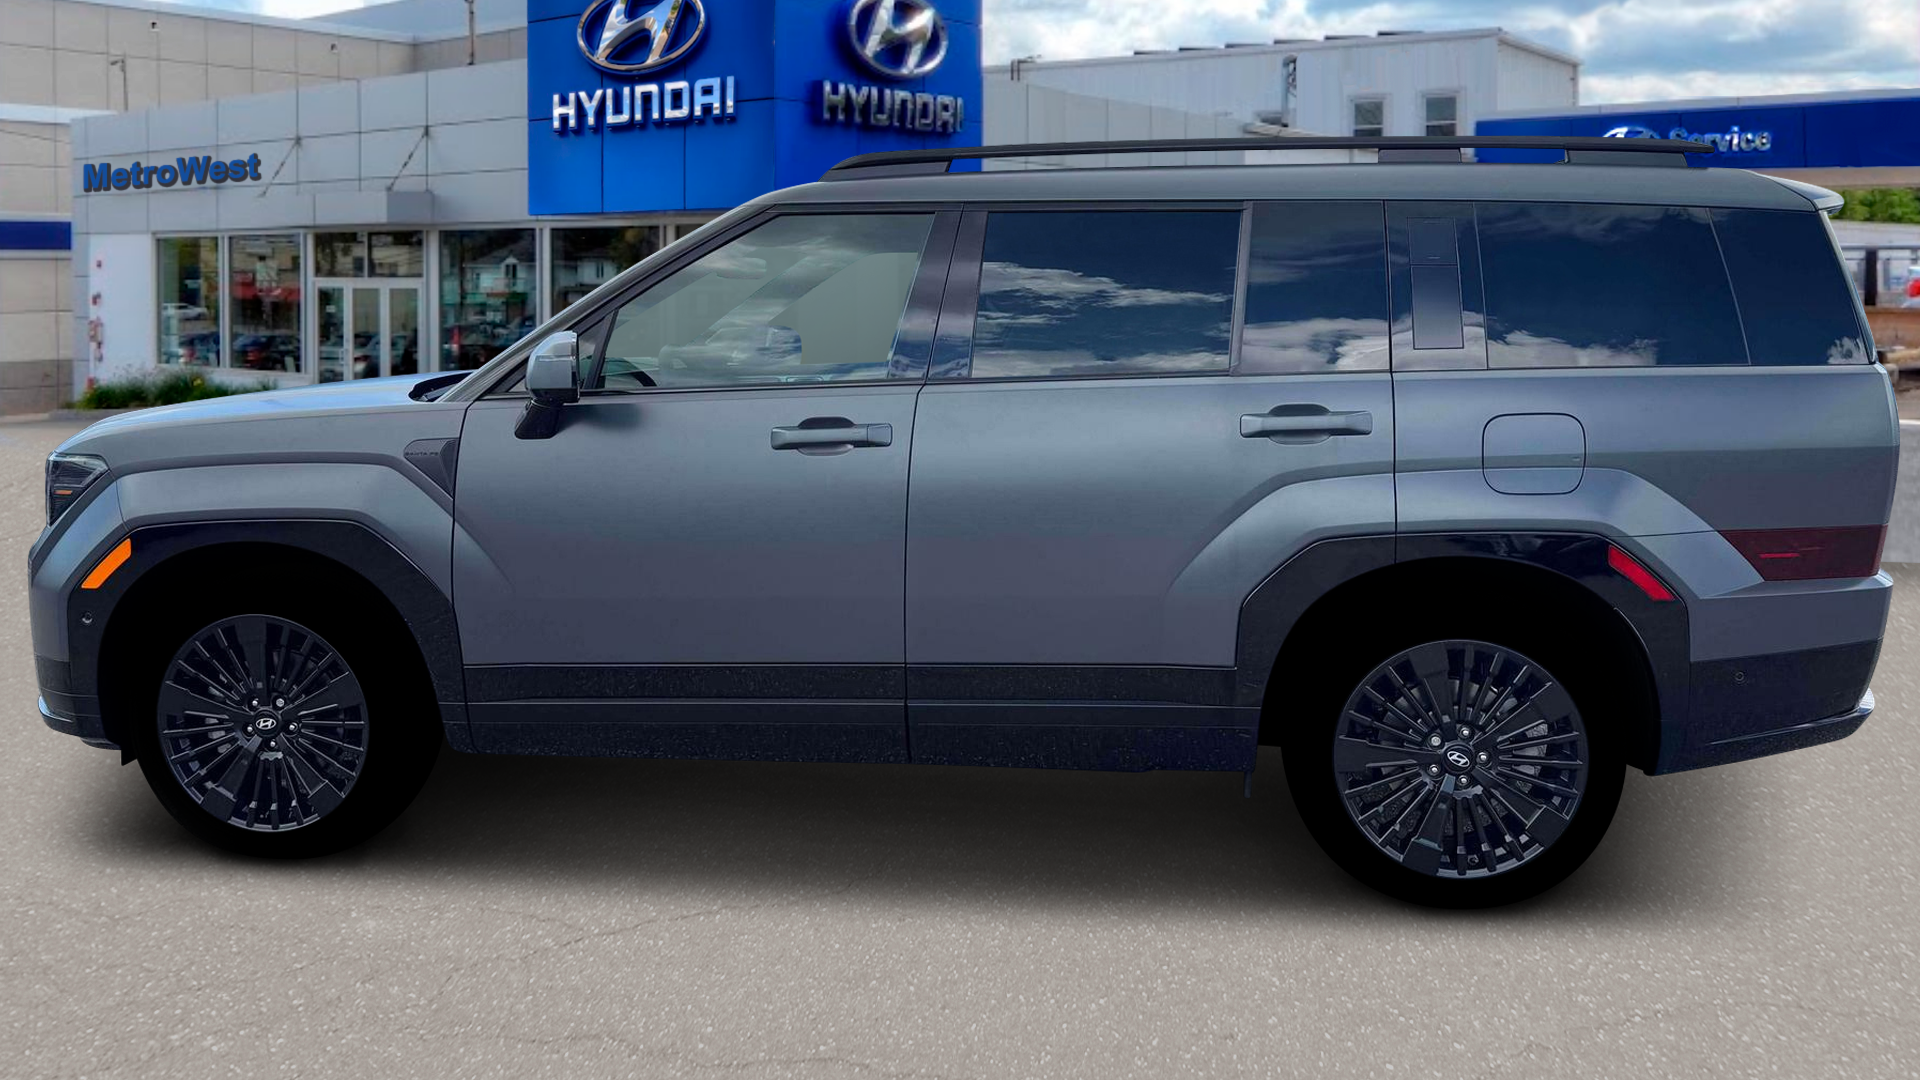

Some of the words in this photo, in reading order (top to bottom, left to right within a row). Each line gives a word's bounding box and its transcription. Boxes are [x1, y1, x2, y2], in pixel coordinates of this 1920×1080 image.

[552, 75, 736, 131] HYUNDAI
[822, 79, 964, 134] HYUNDAI
[1668, 125, 1772, 152] Service
[83, 152, 262, 193] MetroWest
